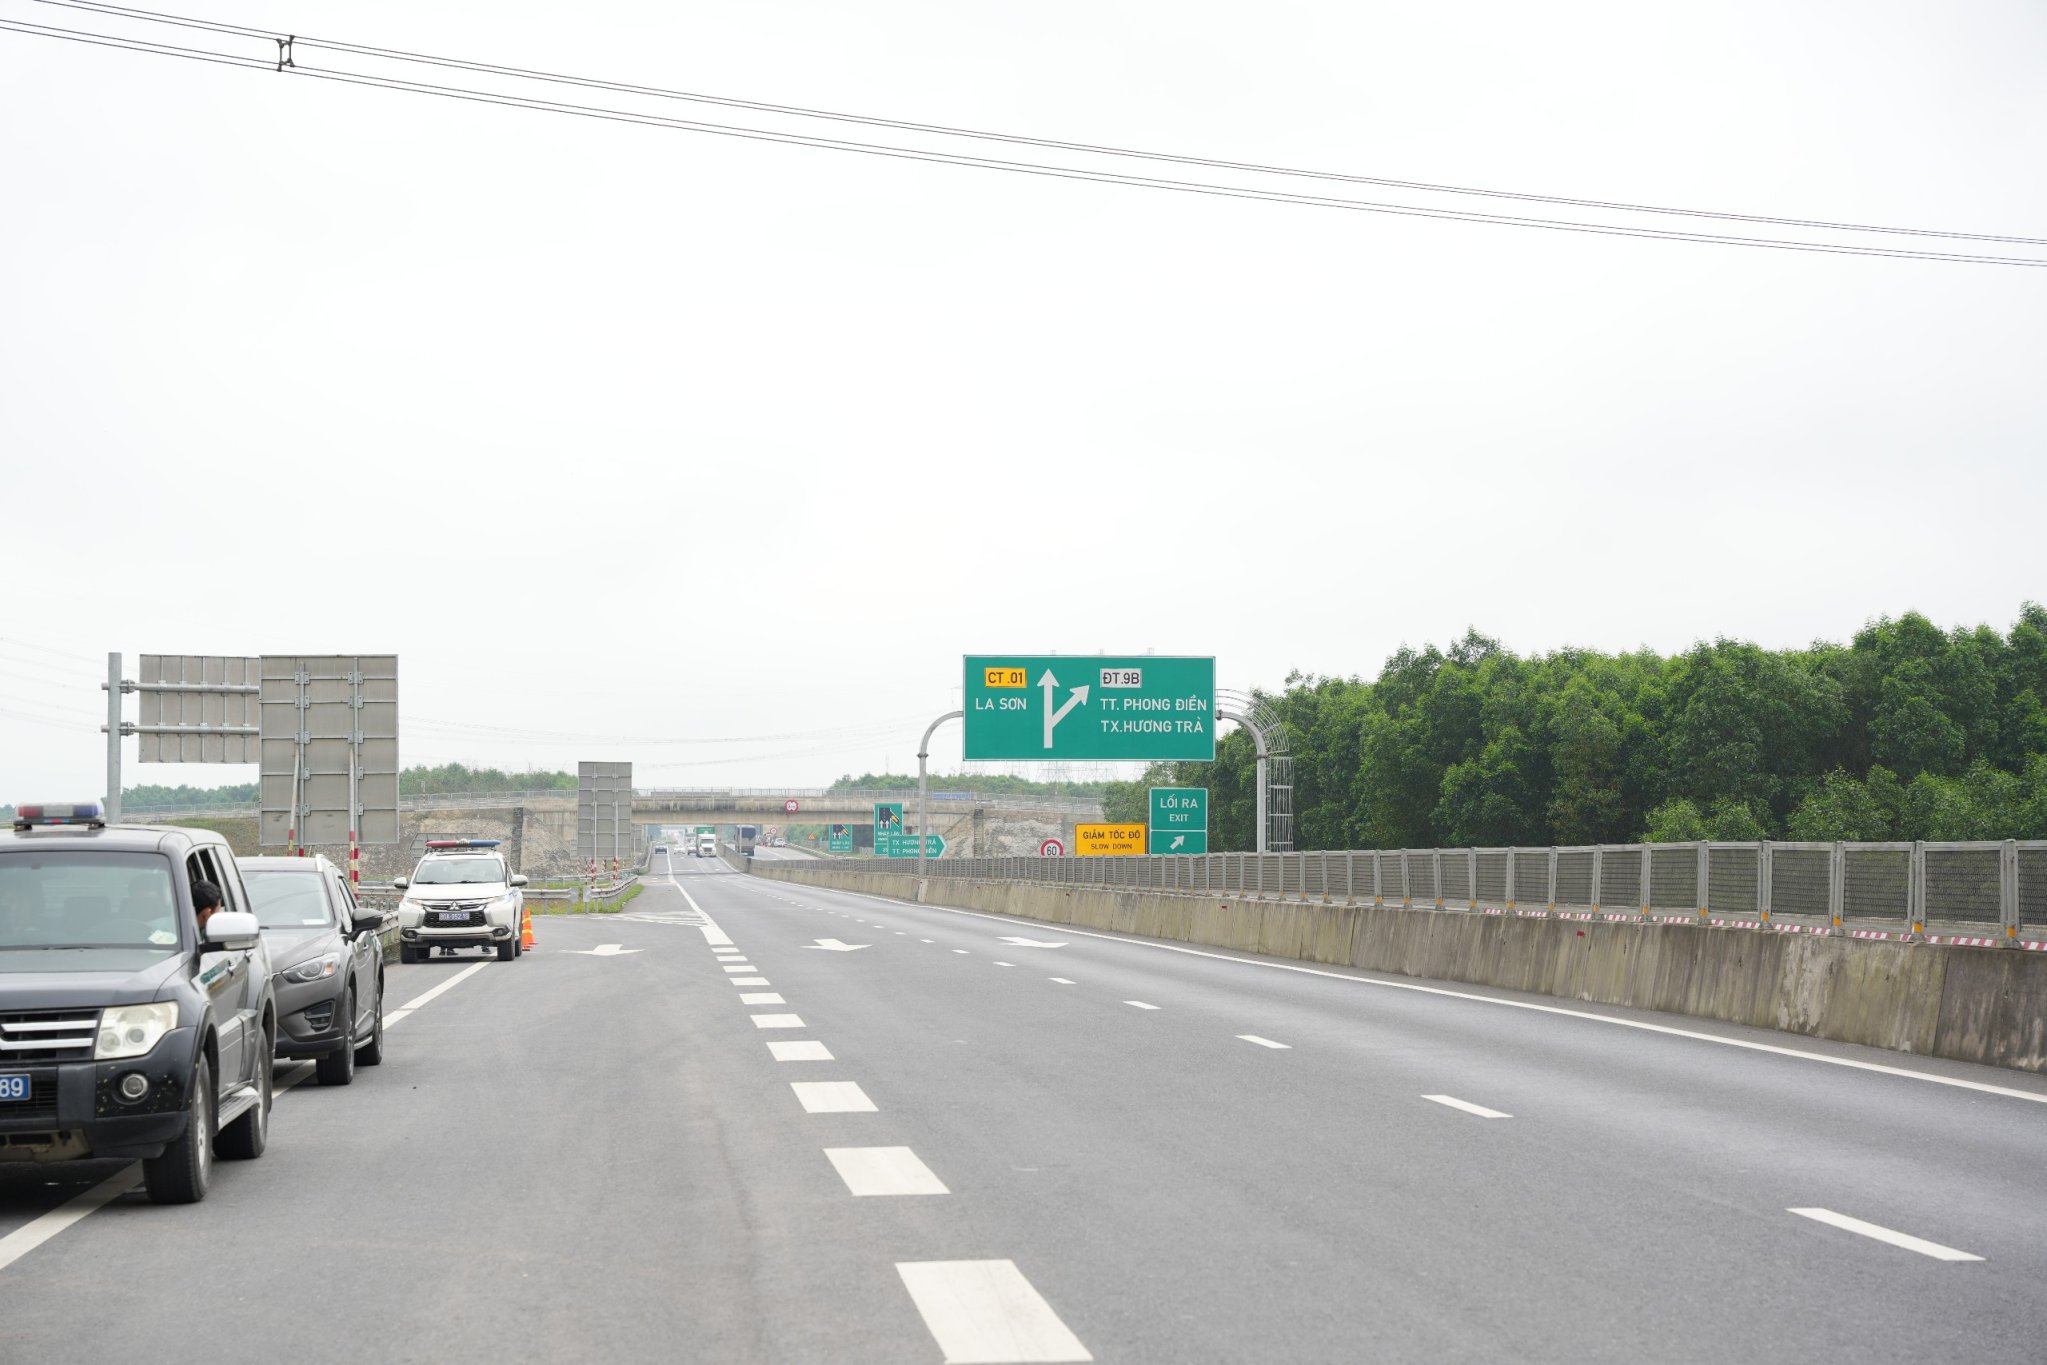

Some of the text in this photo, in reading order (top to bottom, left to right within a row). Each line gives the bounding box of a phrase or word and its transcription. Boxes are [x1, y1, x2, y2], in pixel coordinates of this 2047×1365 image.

[1103, 672, 1140, 684] ĐT.9B
[975, 697, 1027, 710] LA SƠN
[1100, 698, 1120, 711] TT.
[1123, 698, 1171, 711] PHONG
[1175, 716, 1204, 733] TRÀ
[1160, 794, 1198, 808] LỐI RA
[1169, 814, 1189, 822] EXIT
[1083, 828, 1141, 840] GIẢM TỐC ĐỘ
[1046, 846, 1057, 856] 60
